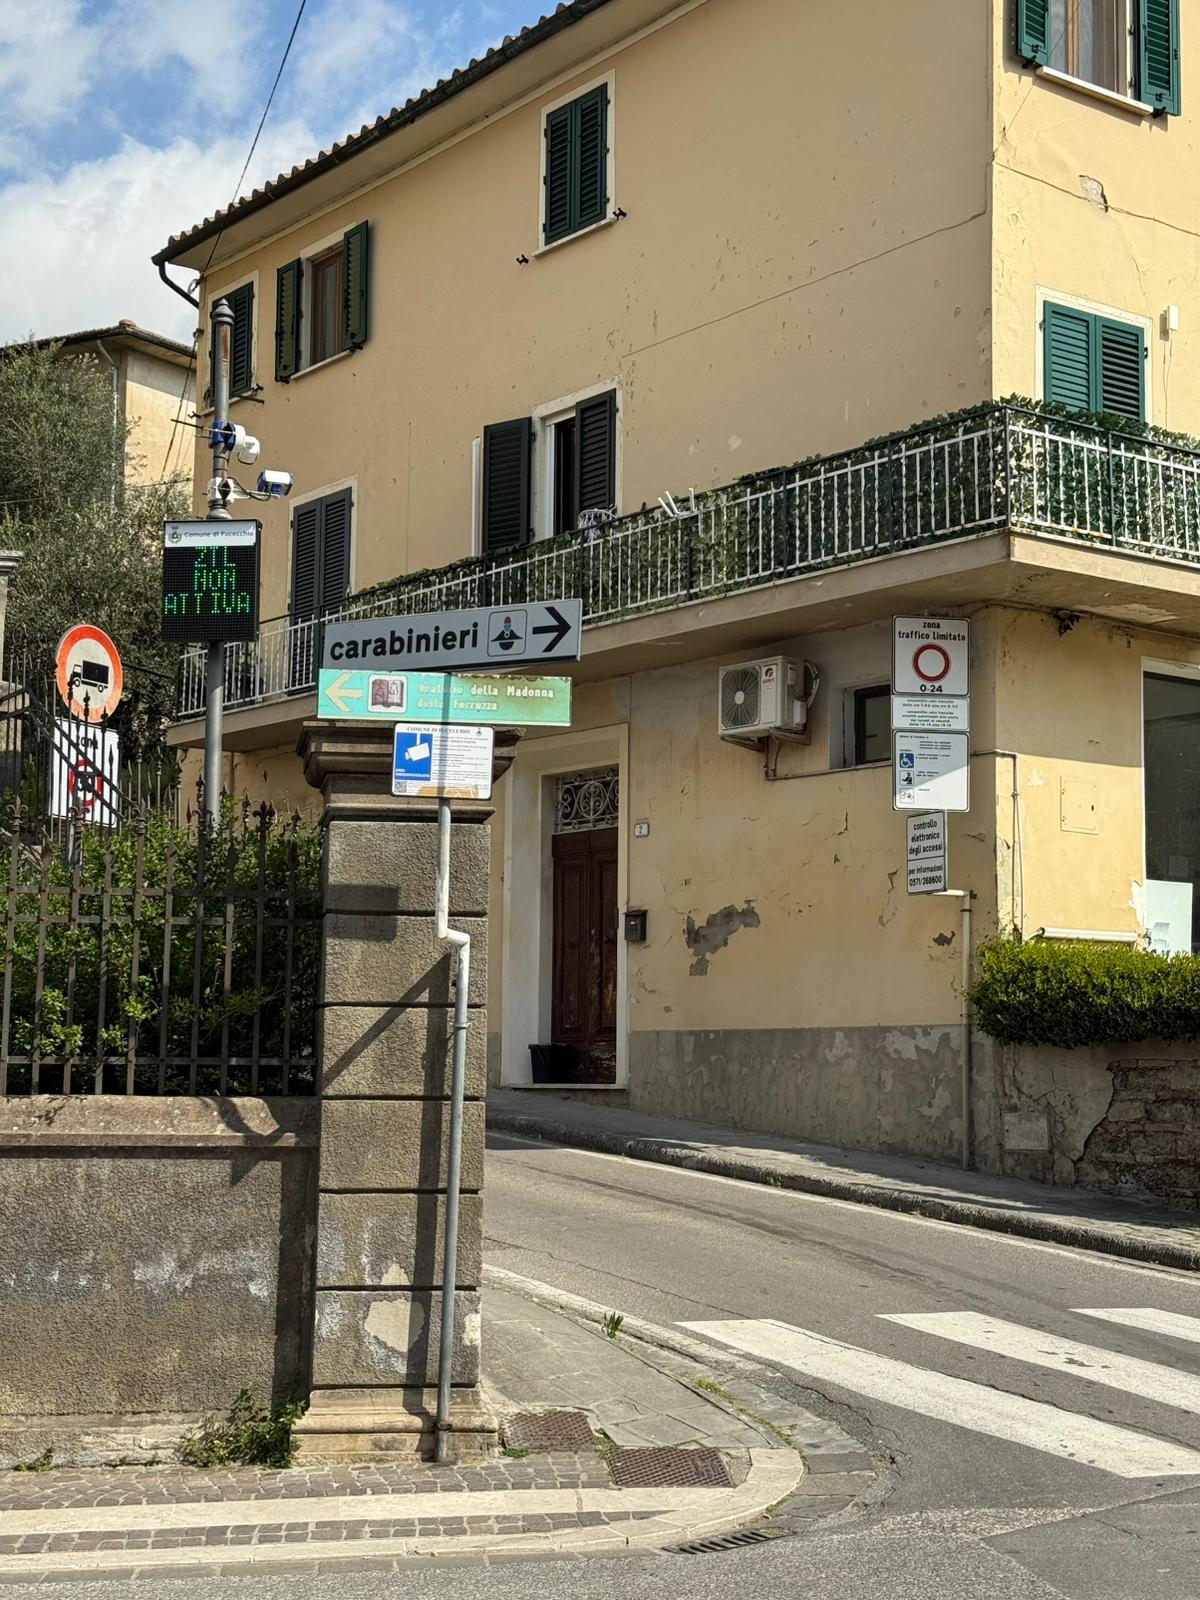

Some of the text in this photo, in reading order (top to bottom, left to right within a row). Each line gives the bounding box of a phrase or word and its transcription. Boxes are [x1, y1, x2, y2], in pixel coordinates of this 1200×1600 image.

[221, 529, 253, 537] Fucecchio
[195, 546, 236, 567] ZTL
[194, 569, 236, 590] NON
[164, 592, 250, 614] ATTIVA
[922, 621, 941, 629] zona
[330, 622, 479, 661] carabinieri
[898, 630, 966, 642] traffico limitato
[470, 684, 499, 696] della
[506, 685, 554, 699] Madonna
[920, 684, 943, 693] 0-24
[913, 819, 937, 830] controllo
[911, 832, 940, 843] elettronico
[908, 842, 943, 856] degli accessi
[916, 864, 943, 874] informazioni
